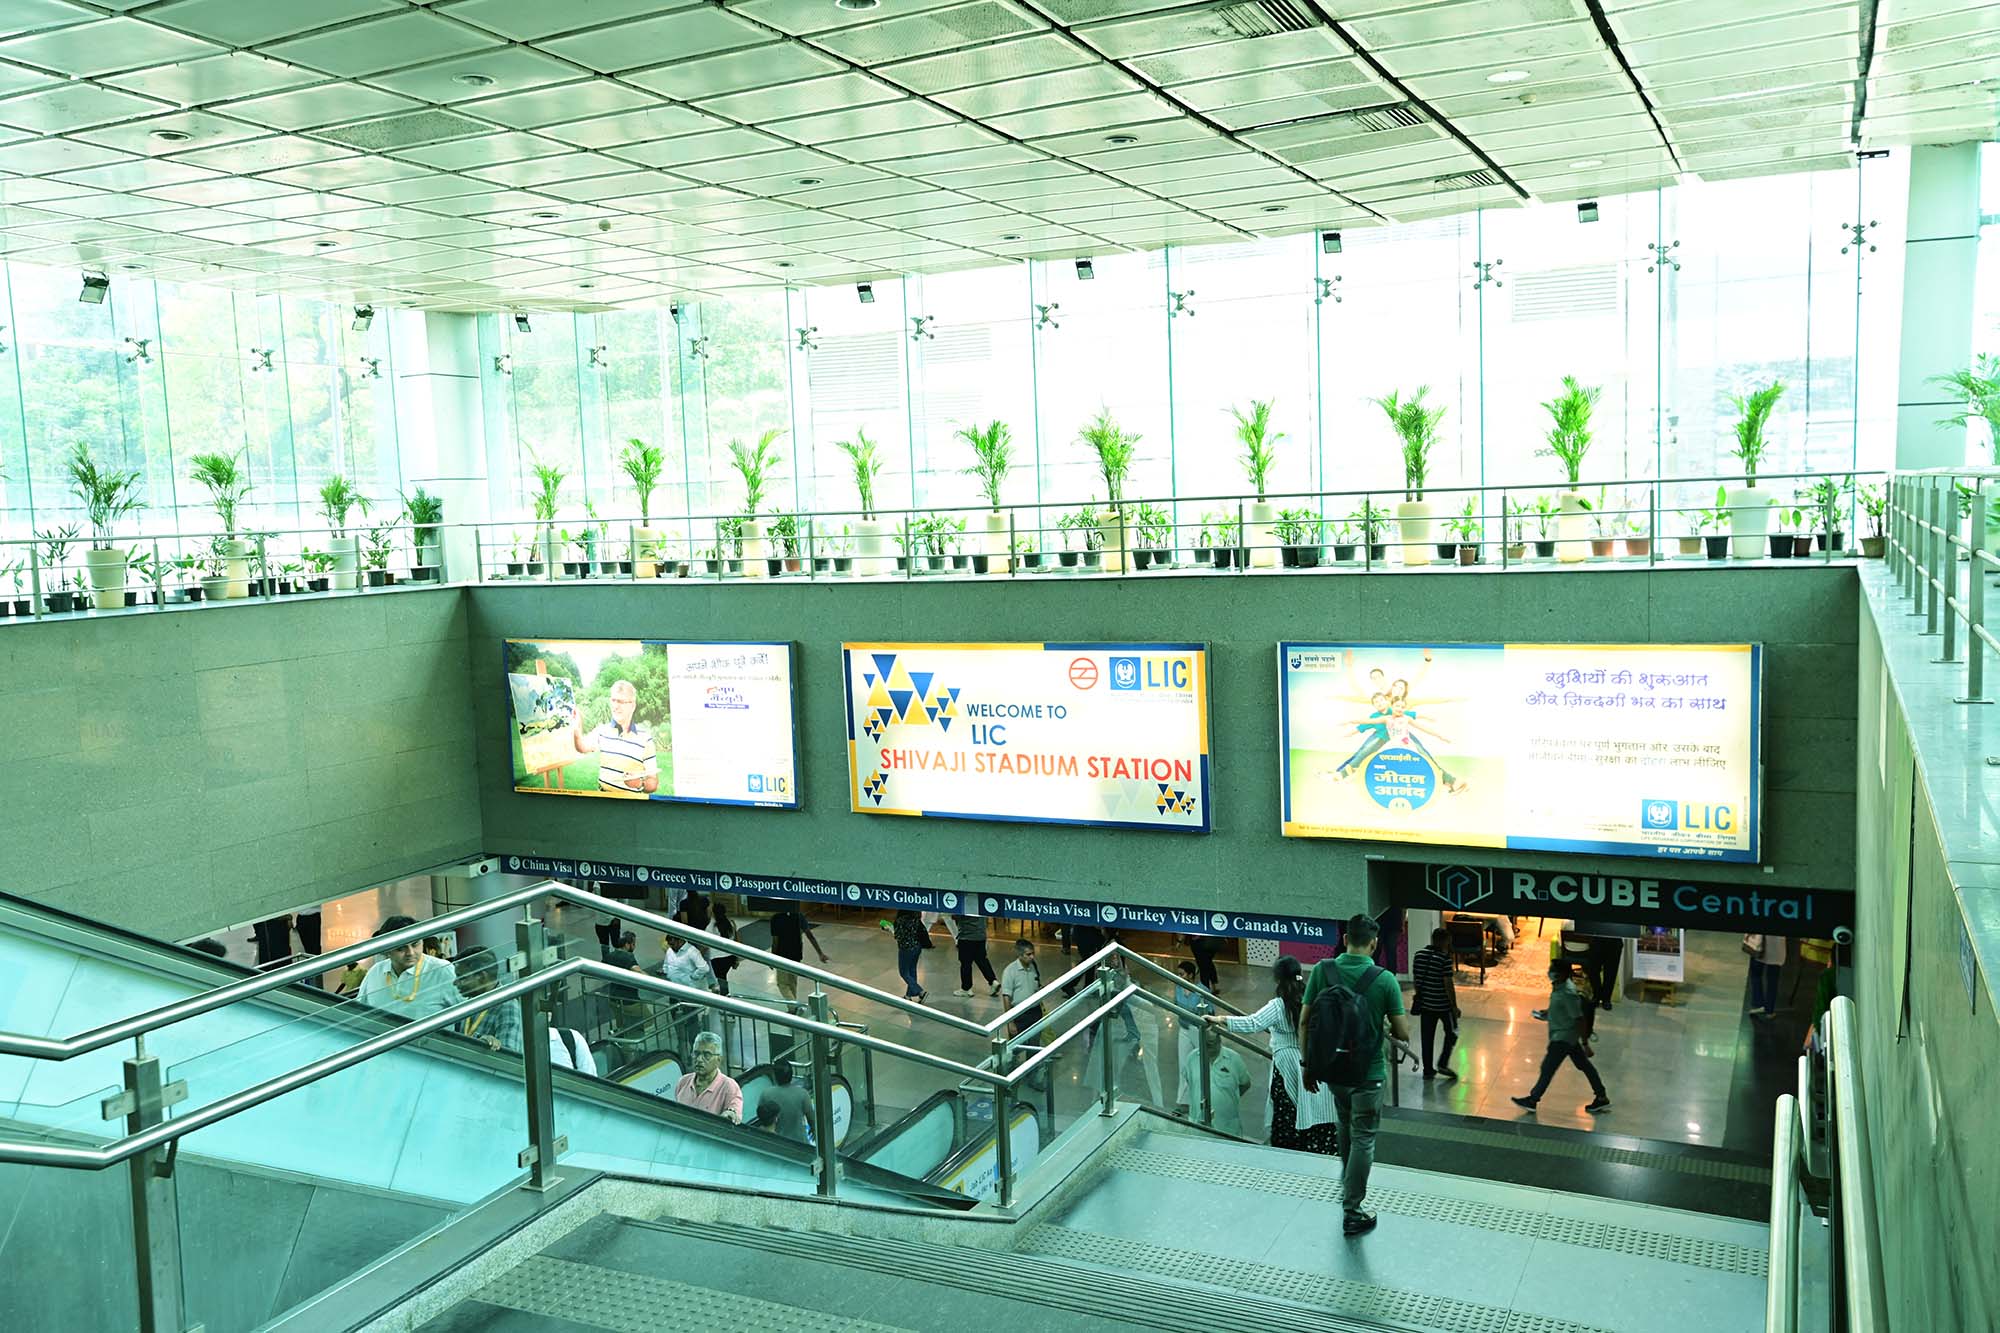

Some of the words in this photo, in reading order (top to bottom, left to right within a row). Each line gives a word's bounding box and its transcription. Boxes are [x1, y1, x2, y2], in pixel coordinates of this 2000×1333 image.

[1147, 660, 1187, 688] LIC
[1545, 669, 1606, 689] खुशियों
[1610, 669, 1632, 685] की
[1525, 690, 1558, 706] और
[1630, 696, 1656, 709] भर
[1661, 696, 1683, 709] का
[1689, 697, 1728, 711] साथ
[966, 703, 1043, 719] WELCOME
[1045, 705, 1067, 720] TO
[971, 723, 1007, 745] LIC
[1613, 740, 1646, 754] भुगतान
[1650, 739, 1668, 752] और
[880, 748, 966, 773] SHIVAJI
[975, 752, 1078, 777] STADIUM
[1088, 756, 1192, 782] STATION
[766, 777, 785, 793] LIC
[1373, 770, 1426, 785] जीवन
[1374, 784, 1426, 798] आनंद
[1685, 804, 1731, 831] LIC
[522, 859, 550, 872] China
[551, 861, 572, 873] Visa
[593, 865, 607, 877] US
[609, 866, 630, 878] Visa
[651, 870, 687, 884] Greece
[690, 873, 712, 886] Visa
[735, 876, 780, 892] Passport
[783, 879, 837, 895] Collection
[865, 888, 890, 902] VFS
[894, 890, 932, 905] Global
[1673, 885, 1813, 921] Central
[1004, 898, 1060, 917] Malaysia
[1063, 904, 1091, 918] Visa
[1119, 906, 1166, 926] Turkey
[1170, 911, 1200, 925] Visa
[1233, 916, 1288, 934] Canada
[1292, 922, 1323, 937] Visa
